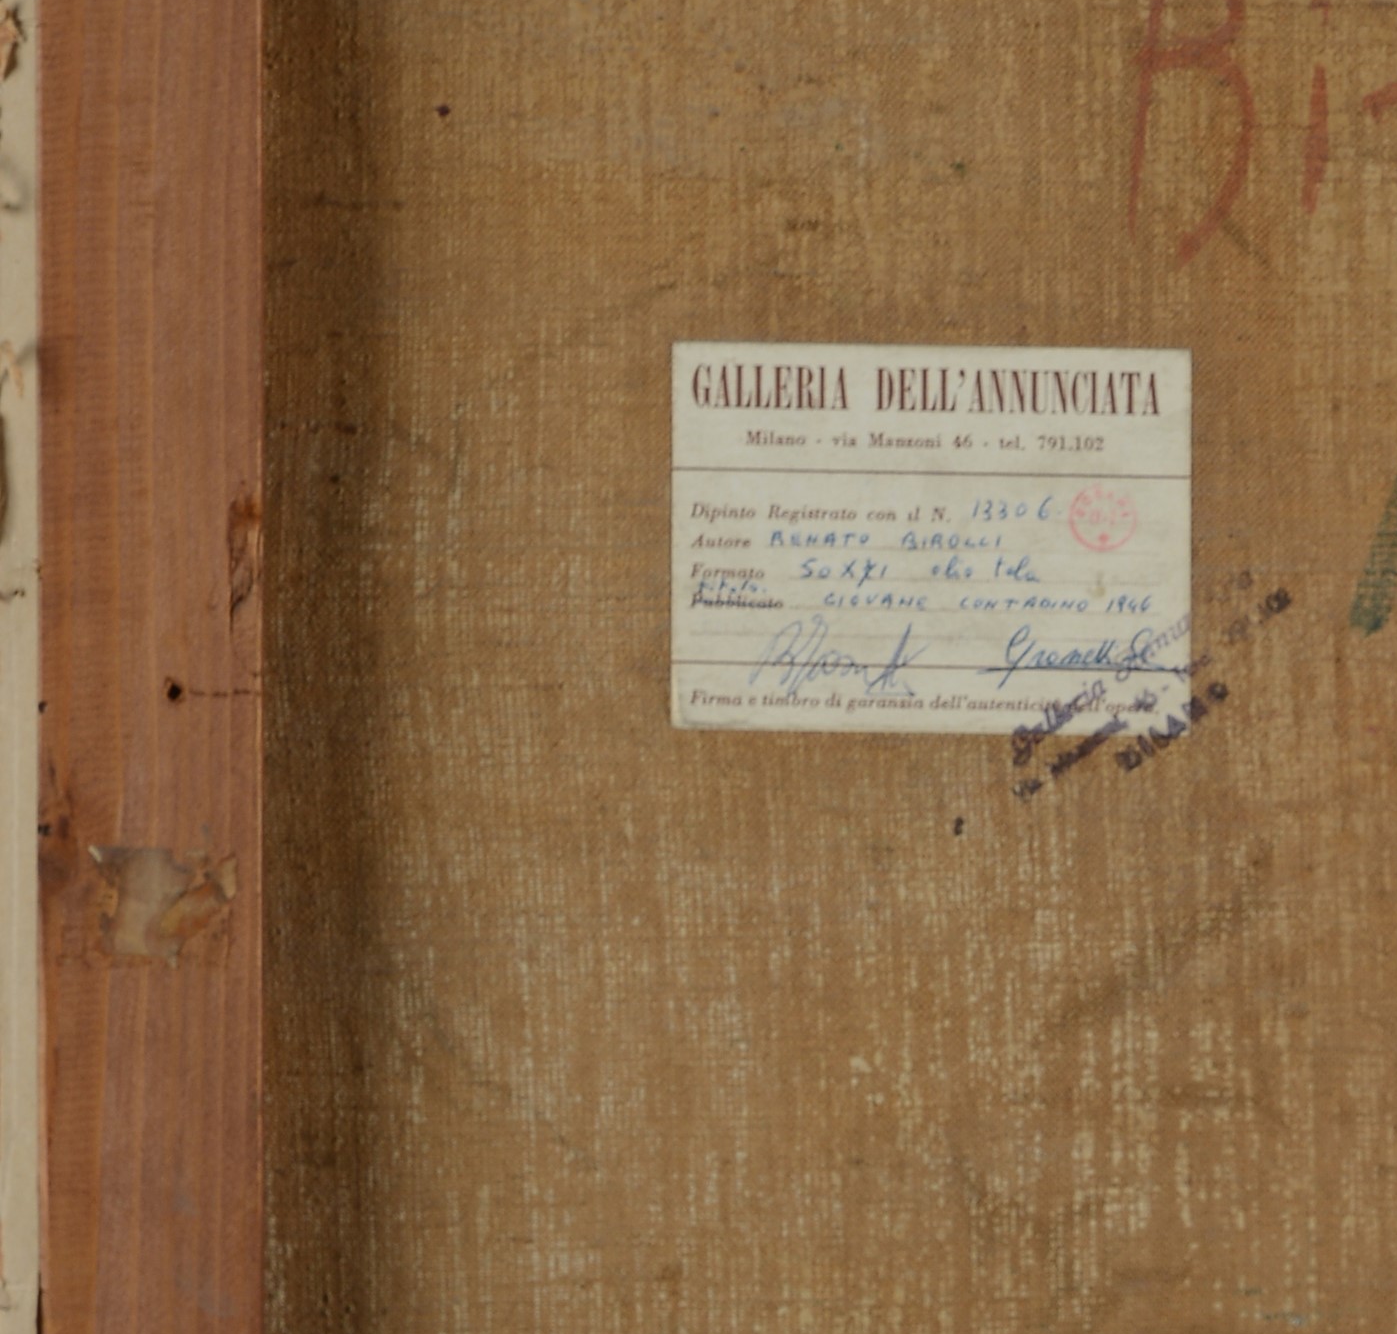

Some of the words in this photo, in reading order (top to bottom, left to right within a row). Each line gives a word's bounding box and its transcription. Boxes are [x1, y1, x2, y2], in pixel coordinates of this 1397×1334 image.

[690, 361, 850, 411] GALLERIA
[875, 366, 1161, 416] DELL'ANNUNCIATA
[745, 429, 807, 447] Milano
[831, 434, 858, 449] via
[868, 432, 942, 450] Manzoni
[952, 434, 973, 449] 46
[999, 435, 1026, 451] tel.
[1037, 435, 1105, 452] 791.102
[690, 502, 757, 524] Dipinto
[767, 503, 858, 523] Registrato
[866, 509, 897, 523] con
[930, 506, 952, 523] N.
[690, 533, 753, 549] Autore
[769, 529, 871, 547] RENATO
[901, 530, 1002, 551] BIROLLI
[690, 561, 765, 581] Formato
[822, 591, 929, 612] GIOVANE
[959, 595, 1090, 613] CONTADINO
[1104, 593, 1153, 614] 1946
[690, 688, 743, 706] Firma
[747, 695, 758, 707] e
[761, 692, 821, 708] timbro
[824, 692, 842, 708] di
[846, 697, 925, 714] garanzia
